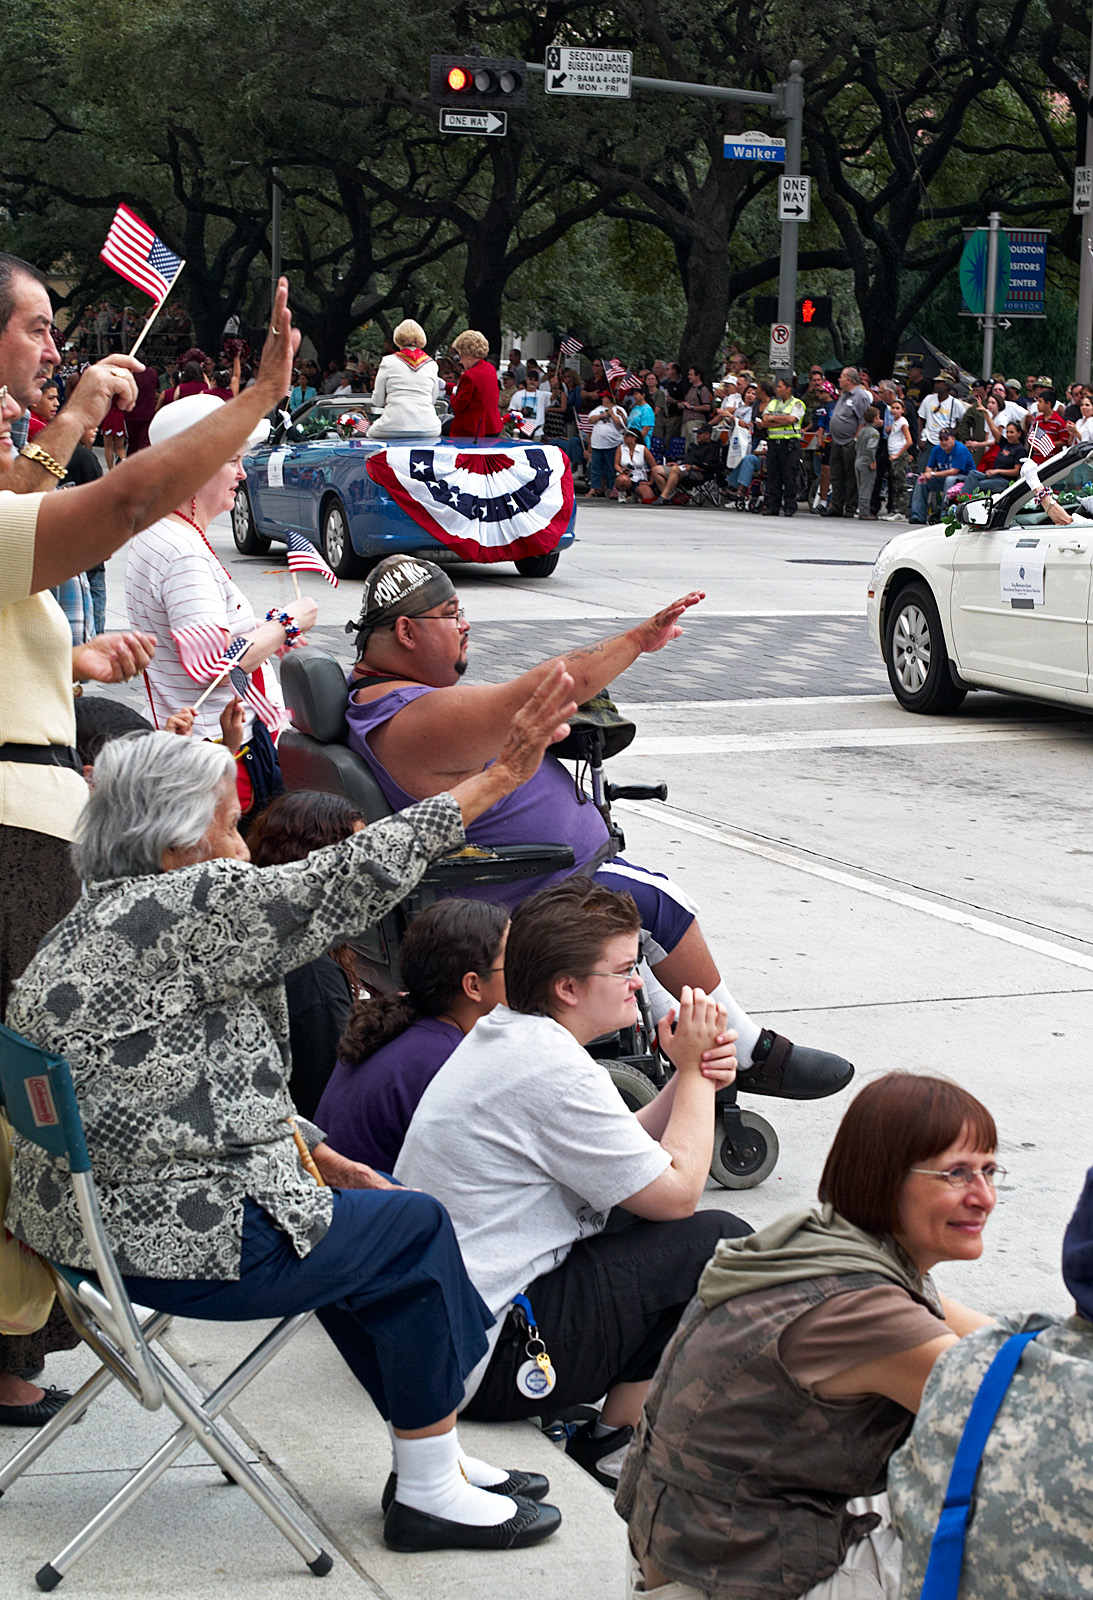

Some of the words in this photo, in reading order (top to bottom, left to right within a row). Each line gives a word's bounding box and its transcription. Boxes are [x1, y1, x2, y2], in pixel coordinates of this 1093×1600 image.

[569, 51, 604, 62] SECOND
[606, 53, 628, 63] LANE
[568, 61, 589, 71] BUSES
[595, 63, 630, 74] CARPOOLS
[568, 74, 595, 83] 7-9AM
[577, 83, 597, 91] MON
[449, 115, 467, 126] ONE
[470, 117, 489, 127] WAY
[733, 146, 777, 159] Walker
[1076, 170, 1091, 182] ONE
[783, 179, 807, 191] ONE
[782, 191, 807, 203] WAY
[1008, 245, 1044, 254] OUSTON
[1009, 262, 1041, 271] ISITORS
[374, 572, 400, 607] POW
[397, 561, 429, 584] MIA
[399, 588, 409, 598] NOT
